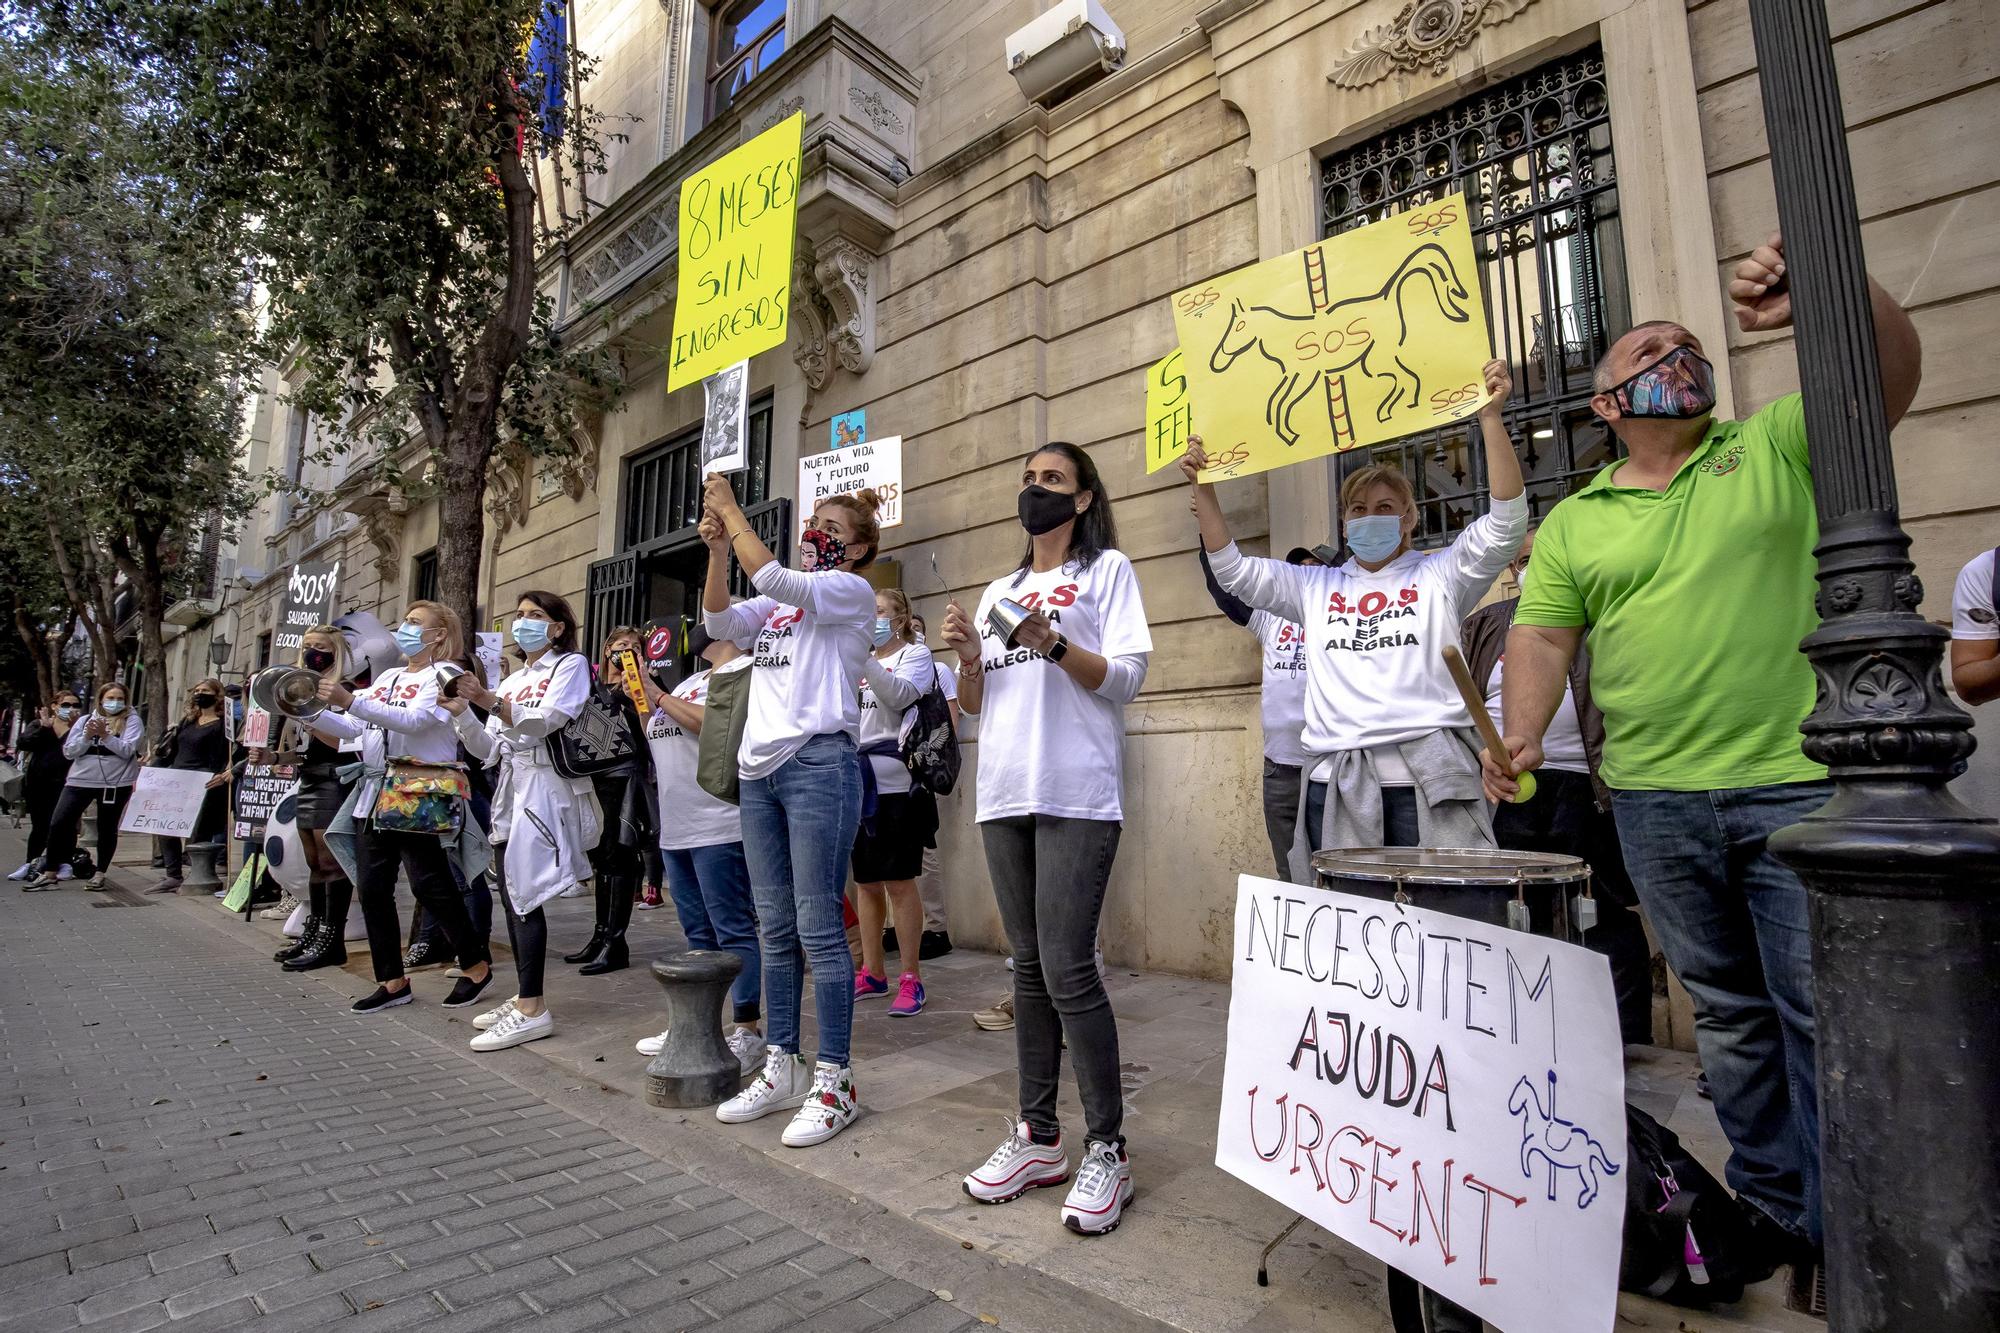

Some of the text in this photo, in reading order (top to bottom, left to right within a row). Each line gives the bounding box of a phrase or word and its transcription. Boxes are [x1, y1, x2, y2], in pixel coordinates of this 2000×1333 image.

[688, 157, 796, 259] 8 MESES
[1408, 204, 1458, 234] SOS
[696, 243, 762, 306] SIN
[1178, 286, 1221, 313] SOS
[672, 286, 786, 371] INGRESOS
[1295, 317, 1371, 361] SOS
[1160, 352, 1187, 406] S
[1430, 383, 1480, 410] SOS
[1155, 402, 1192, 459] FE
[804, 445, 874, 470] NUETRA VIDA
[1205, 442, 1250, 469] SOS
[816, 462, 870, 482] Y FUTURO
[816, 485, 829, 496] EN
[834, 479, 865, 494] JUEGO
[293, 573, 328, 605] SOS
[286, 610, 320, 626] SALVEMOS
[1328, 605, 1416, 627] LA FERIA
[275, 633, 284, 647] EL
[1325, 630, 1419, 652] ALEGRÍA
[1355, 626, 1379, 640] ES
[753, 652, 791, 667] EGRÍA
[757, 642, 770, 653] ES
[985, 648, 1042, 673] ALEGR
[1273, 661, 1307, 671] ALEG
[654, 718, 665, 727] ES
[240, 790, 283, 805] PARA EL OC
[241, 804, 275, 819] INFANT
[1287, 1006, 1456, 1132] AJUDA
[1248, 1086, 1527, 1286] URGENT
